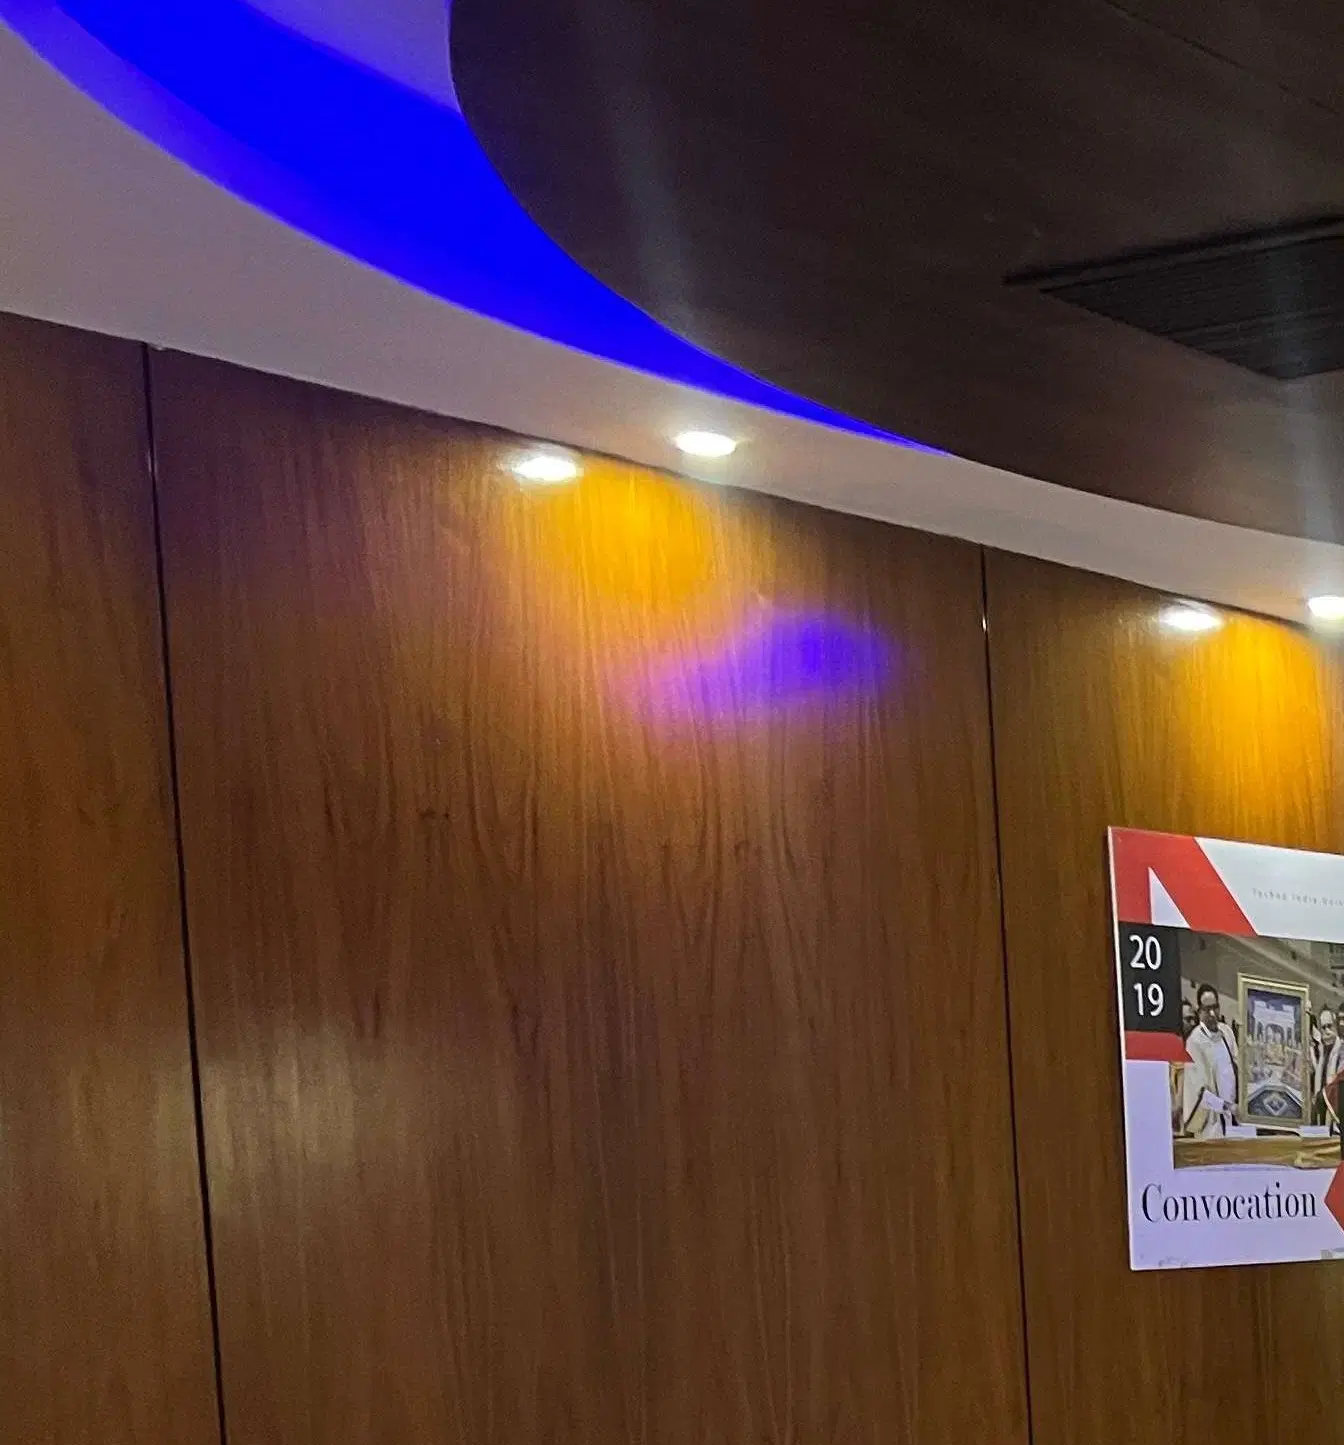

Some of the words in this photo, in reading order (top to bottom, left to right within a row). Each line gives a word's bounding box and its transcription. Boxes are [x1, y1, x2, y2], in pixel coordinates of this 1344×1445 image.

[1129, 934, 1162, 970] 20
[1133, 982, 1164, 1017] 19
[1141, 1181, 1319, 1224] Convocation
